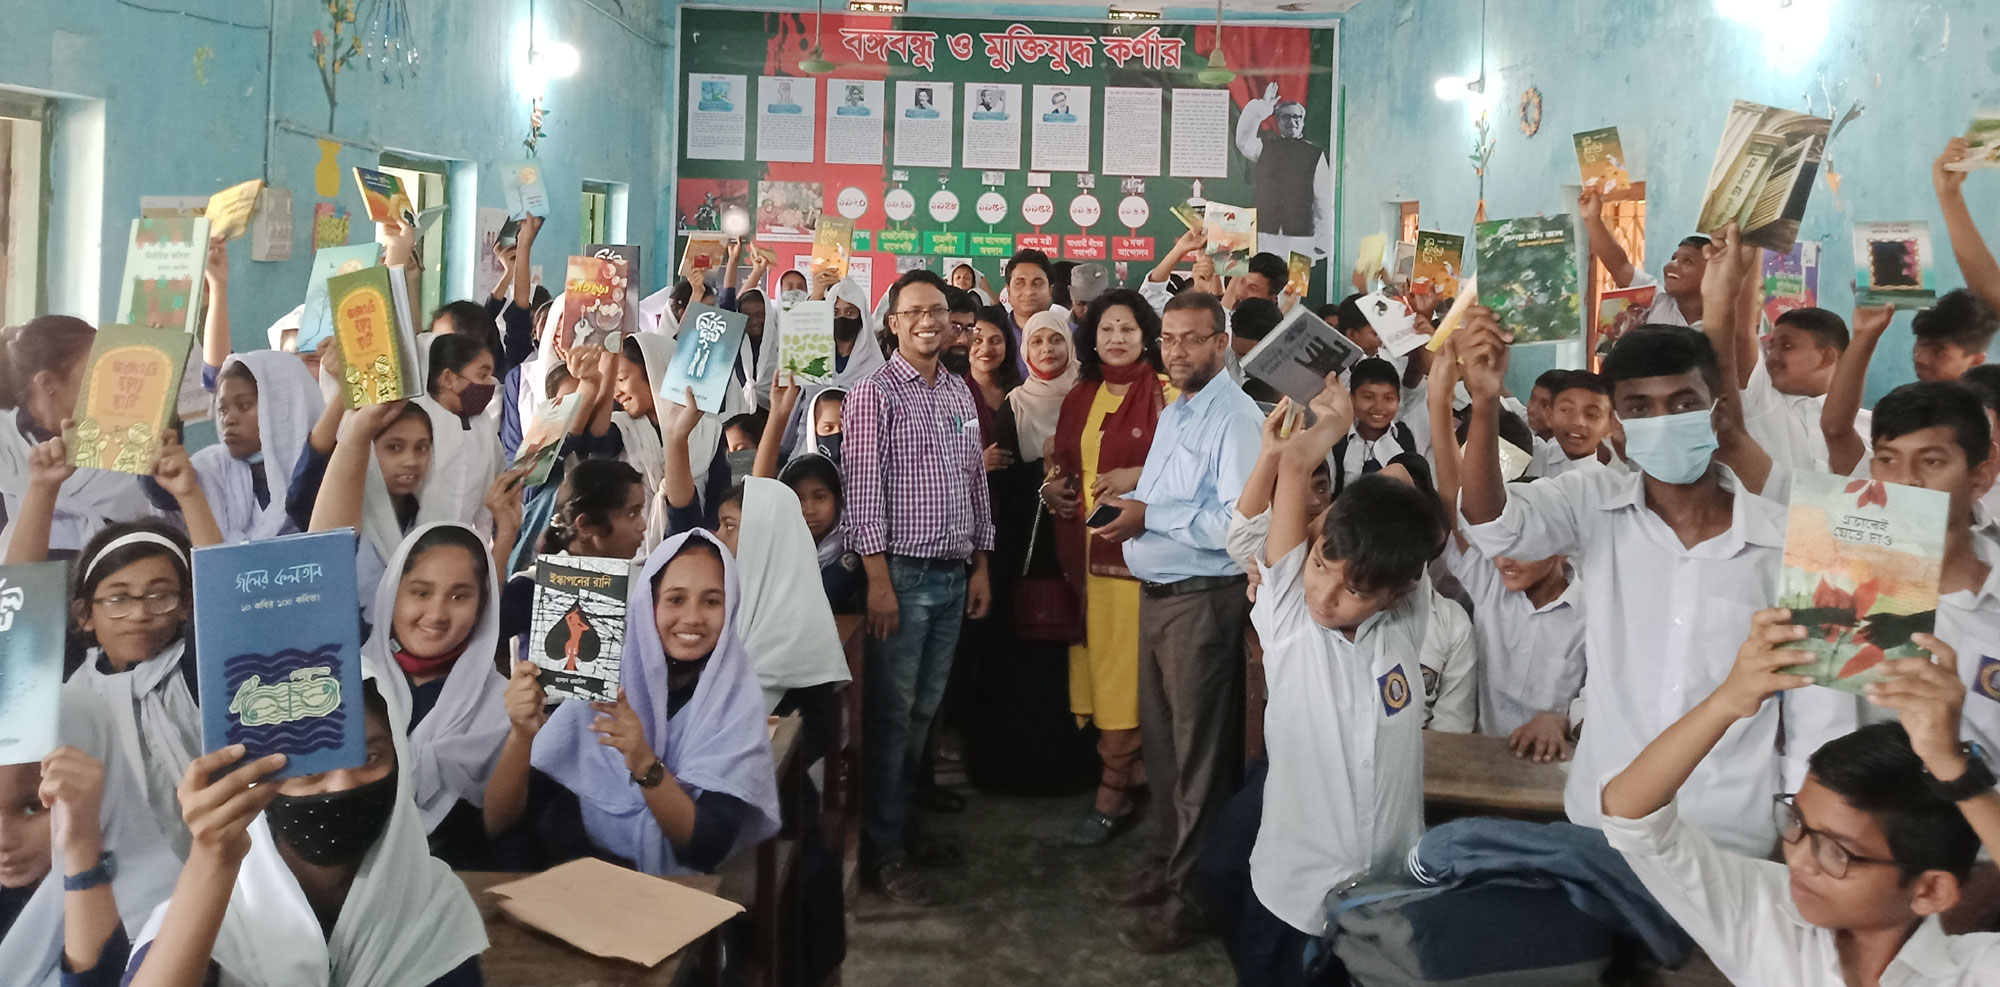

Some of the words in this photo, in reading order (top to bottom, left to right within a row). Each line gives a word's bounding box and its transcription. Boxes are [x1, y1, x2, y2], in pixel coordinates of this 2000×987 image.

[839, 28, 939, 72] বঙ্গবন্ধু
[946, 33, 974, 61] ও
[979, 23, 1097, 74] মুক্তিযুদ্ধ
[1100, 26, 1185, 70] কর্ণার
[1842, 514, 1889, 532] এভাবেই
[1833, 526, 1865, 541] যেতে
[1869, 532, 1892, 546] চাও
[235, 569, 269, 593] জলের
[274, 563, 323, 586] কলতান
[548, 571, 590, 587] ইস্কাপনের
[592, 574, 612, 588] রানি
[241, 604, 252, 612] ১০
[277, 599, 293, 608] ১০০
